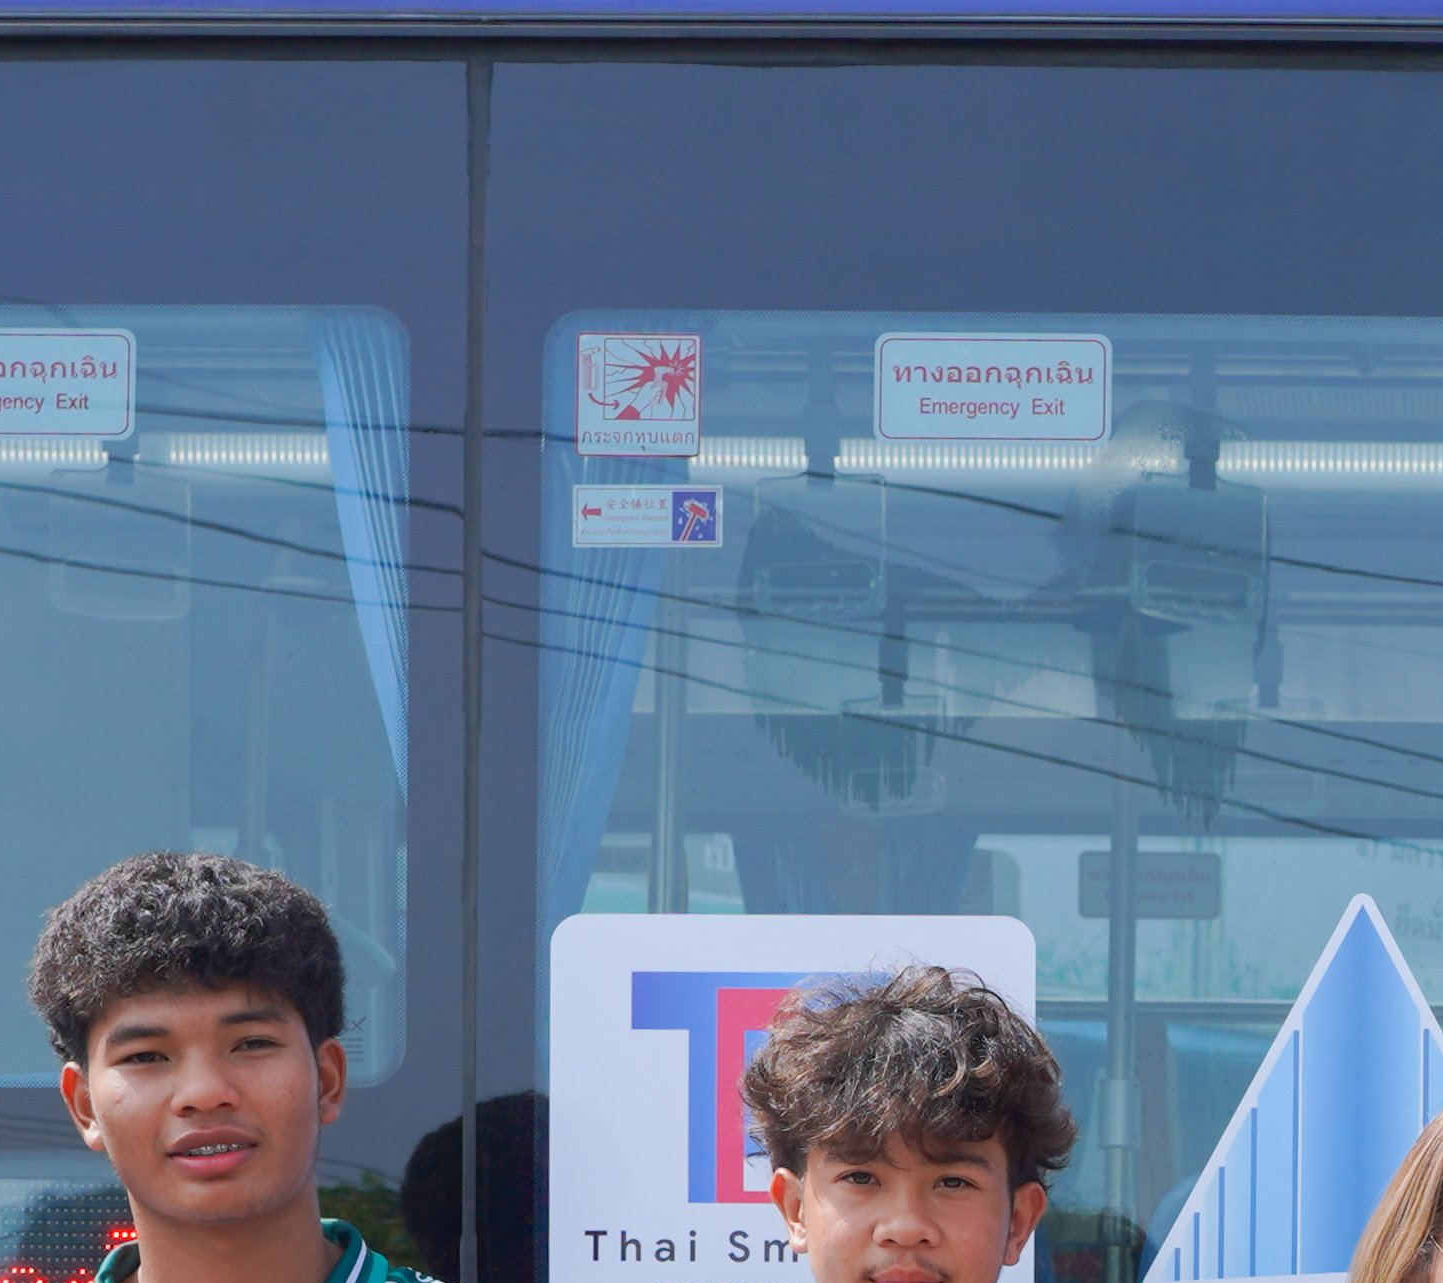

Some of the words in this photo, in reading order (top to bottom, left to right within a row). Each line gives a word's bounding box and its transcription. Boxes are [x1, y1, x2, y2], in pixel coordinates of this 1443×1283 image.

[892, 360, 1095, 389] ทางออกฉุกเฉิน
[55, 392, 89, 409] Exit
[919, 397, 1020, 420] Emergency
[1031, 397, 1066, 416] Exit
[581, 428, 695, 453] กระจกทุบแตก
[584, 1230, 698, 1263] Thai
